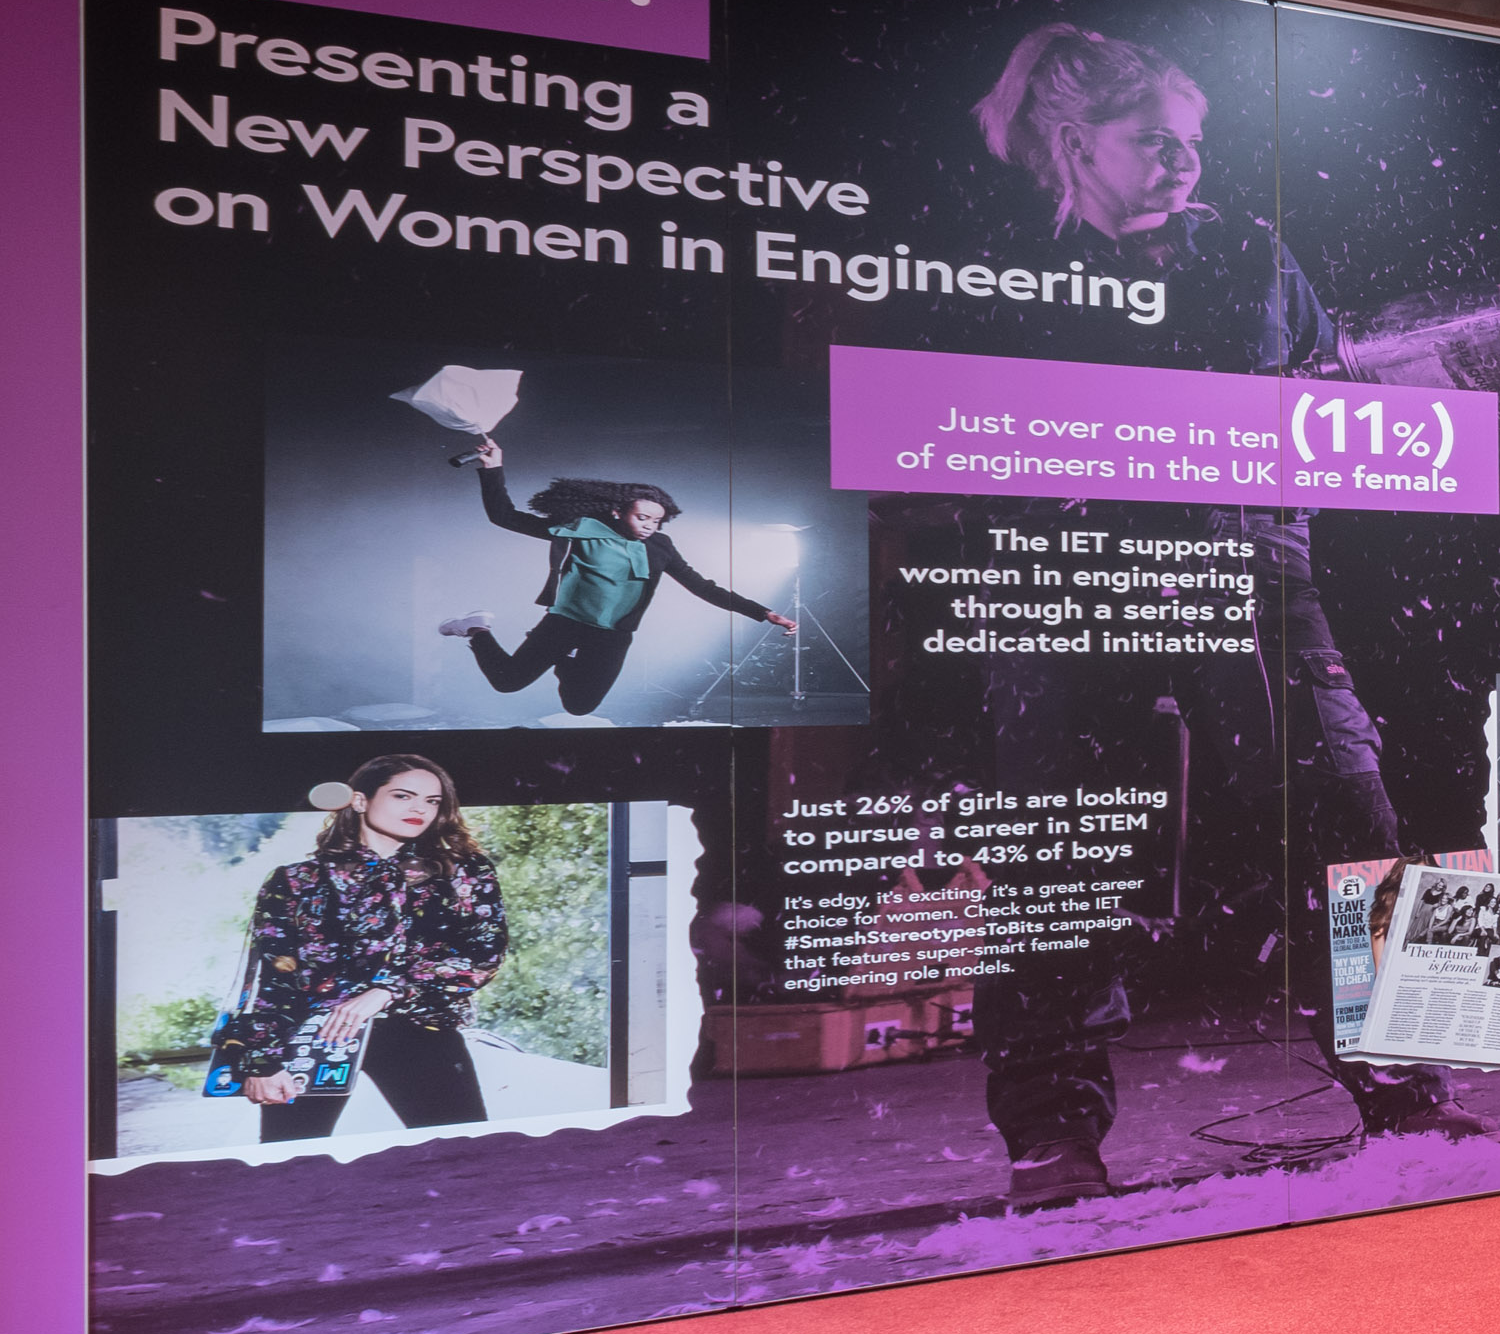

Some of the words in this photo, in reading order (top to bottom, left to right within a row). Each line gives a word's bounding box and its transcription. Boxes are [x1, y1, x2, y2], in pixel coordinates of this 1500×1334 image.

[160, 8, 631, 131] Presenting
[667, 91, 708, 127] a
[160, 89, 368, 161] New
[405, 118, 869, 215] Perspective
[155, 188, 267, 231] on
[302, 185, 627, 264] Women
[662, 221, 723, 273] in
[757, 231, 1165, 325] Engineering
[938, 408, 1015, 435] Just
[1029, 420, 1104, 439] over
[1115, 425, 1176, 443] one
[1189, 423, 1215, 445] in
[1227, 427, 1278, 449] ten
[1292, 392, 1454, 469] (11%)
[897, 443, 935, 469] of
[947, 451, 1115, 479] engineers
[1128, 456, 1154, 479] in
[1166, 456, 1220, 482] the
[1232, 461, 1276, 485] UK
[1294, 471, 1342, 487] are
[1352, 465, 1457, 492] female
[988, 528, 1048, 551] The
[1062, 531, 1108, 553] IET
[1119, 539, 1254, 561] supports
[899, 568, 1020, 584] women
[1034, 565, 1061, 585] in
[1073, 567, 1254, 595] engineering
[951, 596, 1082, 625] through
[1094, 605, 1111, 619] a
[1124, 599, 1214, 620] series
[1225, 599, 1256, 621] of
[924, 629, 1090, 652] dedicated
[1103, 631, 1255, 653] initiatives
[783, 800, 846, 817] Just
[856, 795, 913, 815] 26%
[922, 793, 950, 812] of
[959, 791, 1017, 816] girls
[1026, 795, 1067, 808] are
[1077, 787, 1167, 808] looking
[783, 830, 815, 845] to
[826, 828, 920, 849] pursue
[930, 827, 944, 839] a
[954, 823, 1038, 838] career
[1048, 817, 1069, 833] in
[1080, 813, 1147, 832] STEM
[784, 849, 924, 876] compared
[934, 851, 964, 866] to
[972, 845, 1028, 863] 43%
[1036, 842, 1064, 861] of
[1072, 841, 1132, 863] boys
[786, 897, 812, 909] It's
[819, 893, 870, 910] edgy,
[877, 891, 903, 904] it's
[908, 888, 986, 902] exciting,
[993, 885, 1017, 897] it's
[1023, 887, 1033, 895] a
[1040, 881, 1085, 898] great
[1091, 880, 1144, 891] career
[1342, 883, 1360, 896] £1
[1332, 900, 1366, 915] LEAVE
[1332, 913, 1364, 926] YOUR
[785, 921, 1044, 949] #SmashStereotypesToBits
[1050, 916, 1131, 932] campaign
[1333, 925, 1367, 939] MARK
[1408, 946, 1432, 958] The
[1435, 947, 1473, 960] future
[1428, 961, 1438, 971] is
[1436, 959, 1482, 974] female
[785, 971, 897, 991] engineering
[904, 965, 939, 980] role
[946, 960, 1014, 977] models.
